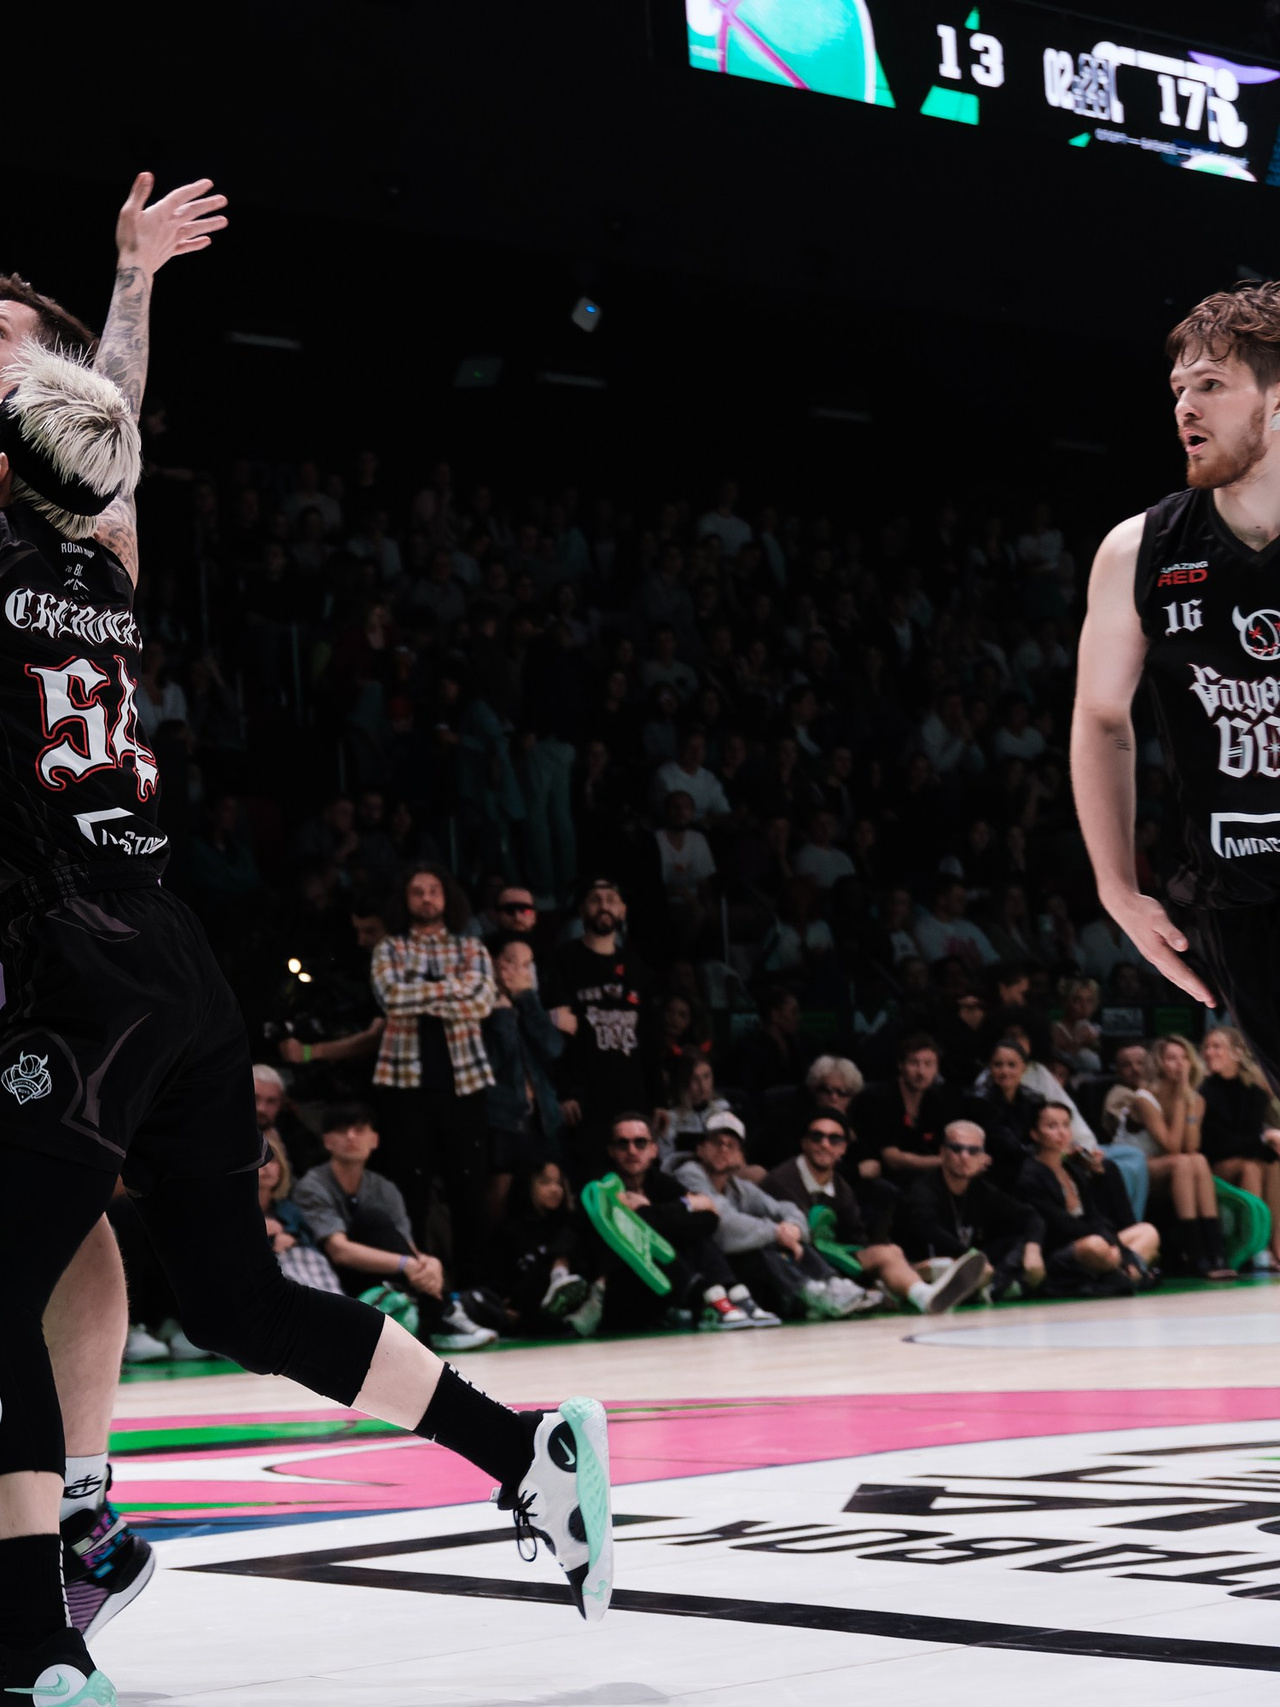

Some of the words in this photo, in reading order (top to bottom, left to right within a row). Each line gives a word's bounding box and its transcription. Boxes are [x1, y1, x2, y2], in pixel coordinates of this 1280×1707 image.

[1157, 569, 1208, 587] RED
[1162, 599, 1203, 636] 16
[25, 655, 159, 802] 54
[613, 1519, 1280, 1601] ТАВОК
